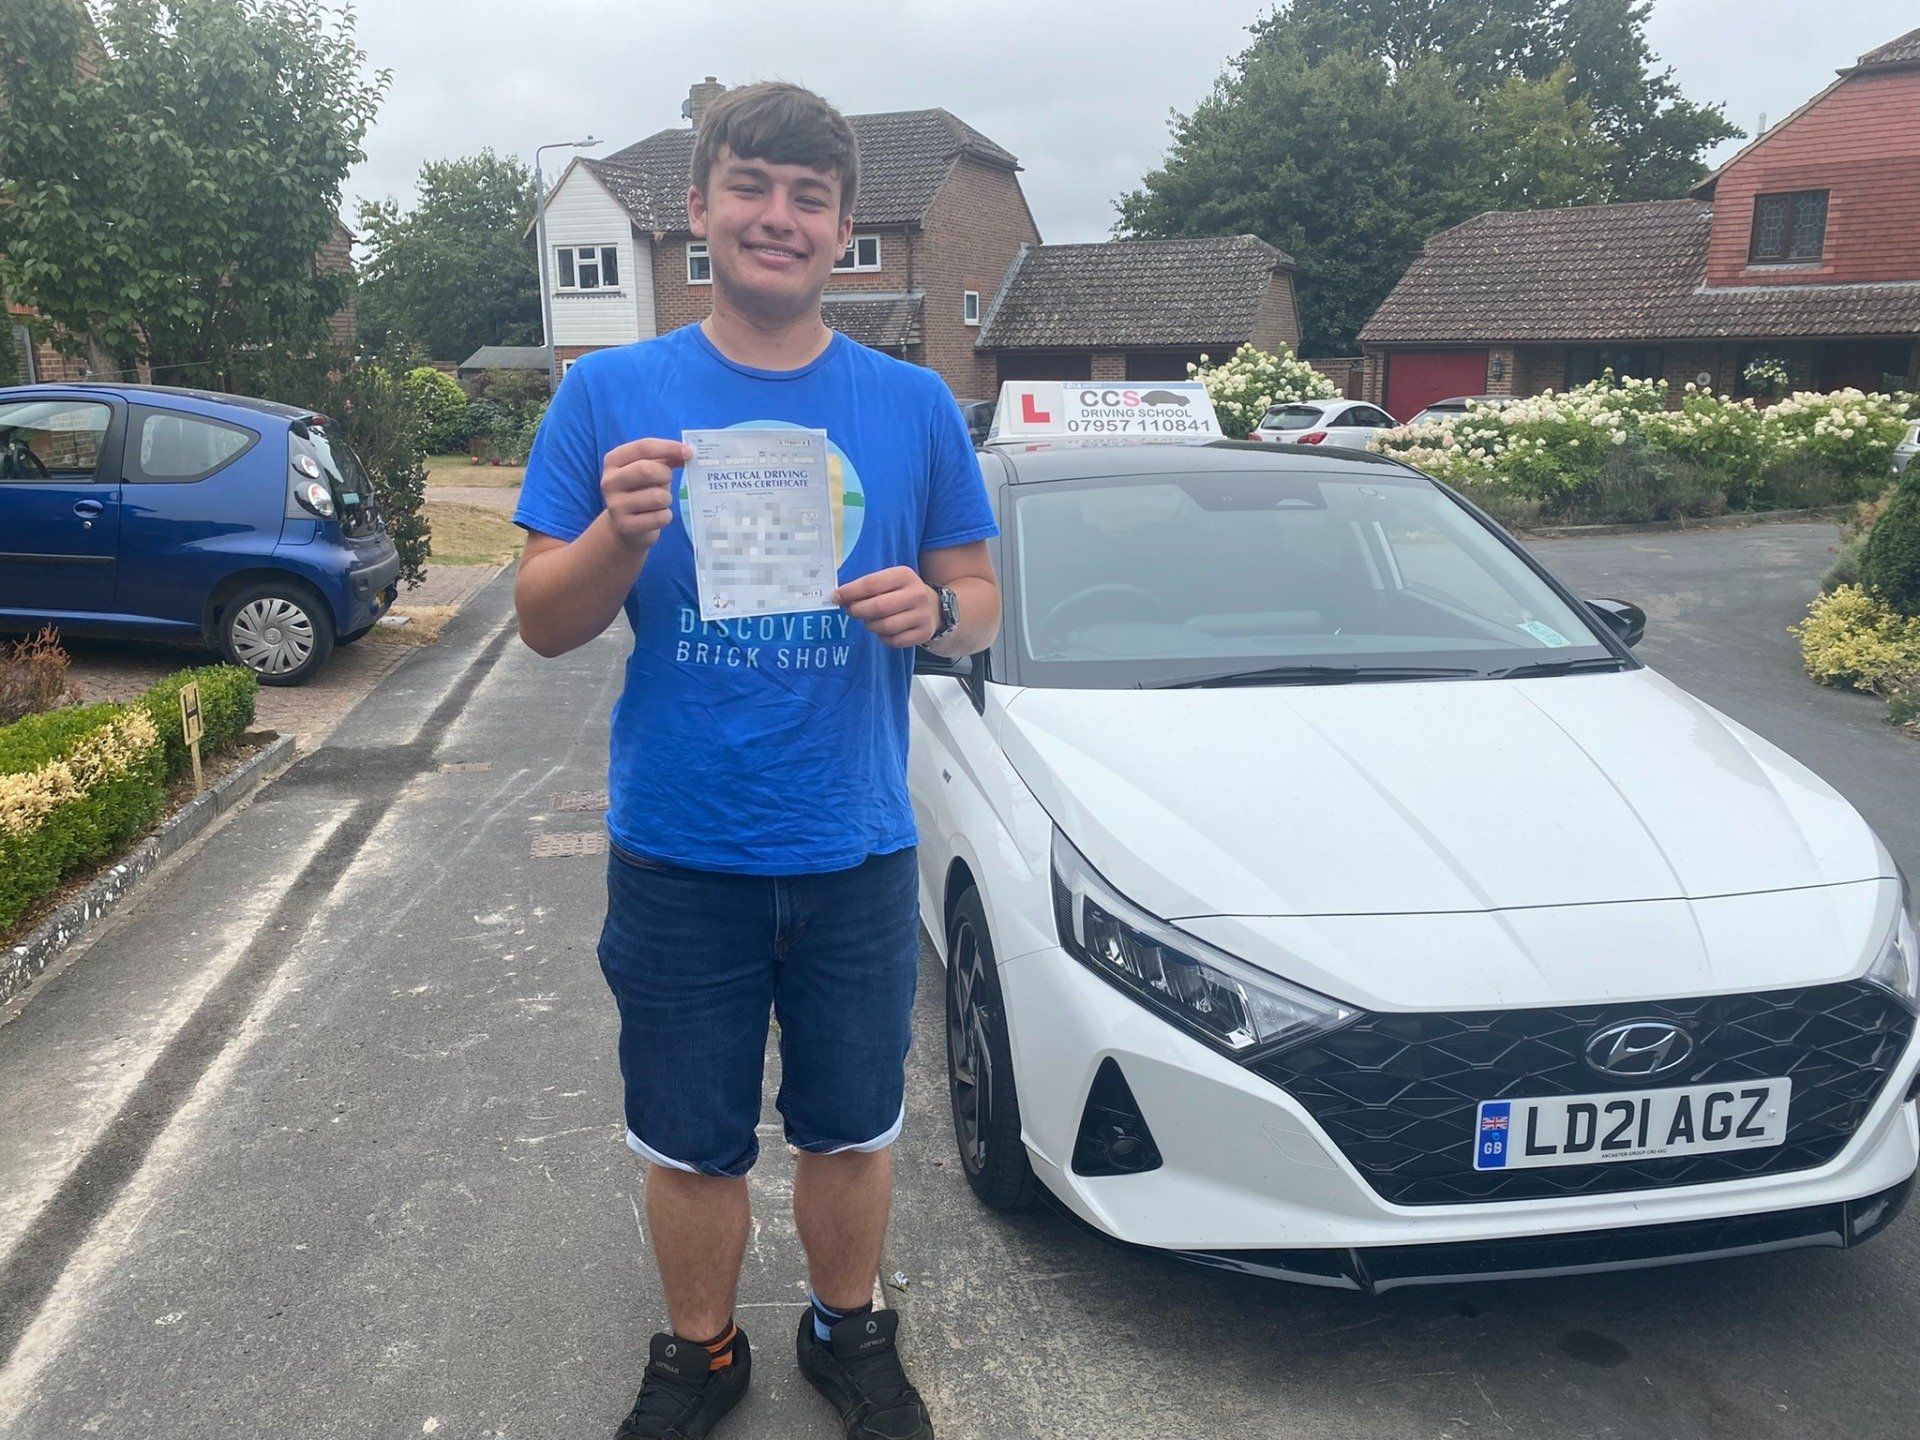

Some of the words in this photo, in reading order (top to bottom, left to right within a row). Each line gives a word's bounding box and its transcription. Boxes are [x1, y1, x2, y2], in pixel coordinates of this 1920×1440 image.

[1079, 390, 1142, 408] CCS
[1021, 393, 1051, 424] L
[1081, 408, 1135, 418] DRIVING
[1138, 408, 1193, 418] SCHOOL
[1067, 419, 1131, 432] 07957
[1137, 419, 1211, 432] 110841
[707, 471, 761, 482] PRACTICAL
[764, 469, 808, 480] DRIVING
[709, 481, 729, 491] TEST
[731, 480, 752, 489] PASS
[754, 479, 809, 488] CERTIFICATE
[676, 640, 760, 669] BRICK
[777, 645, 850, 669] SHOW
[1525, 1098, 1651, 1157] LD21
[1665, 1087, 1771, 1146] AGZ
[1483, 1141, 1503, 1156] GB
